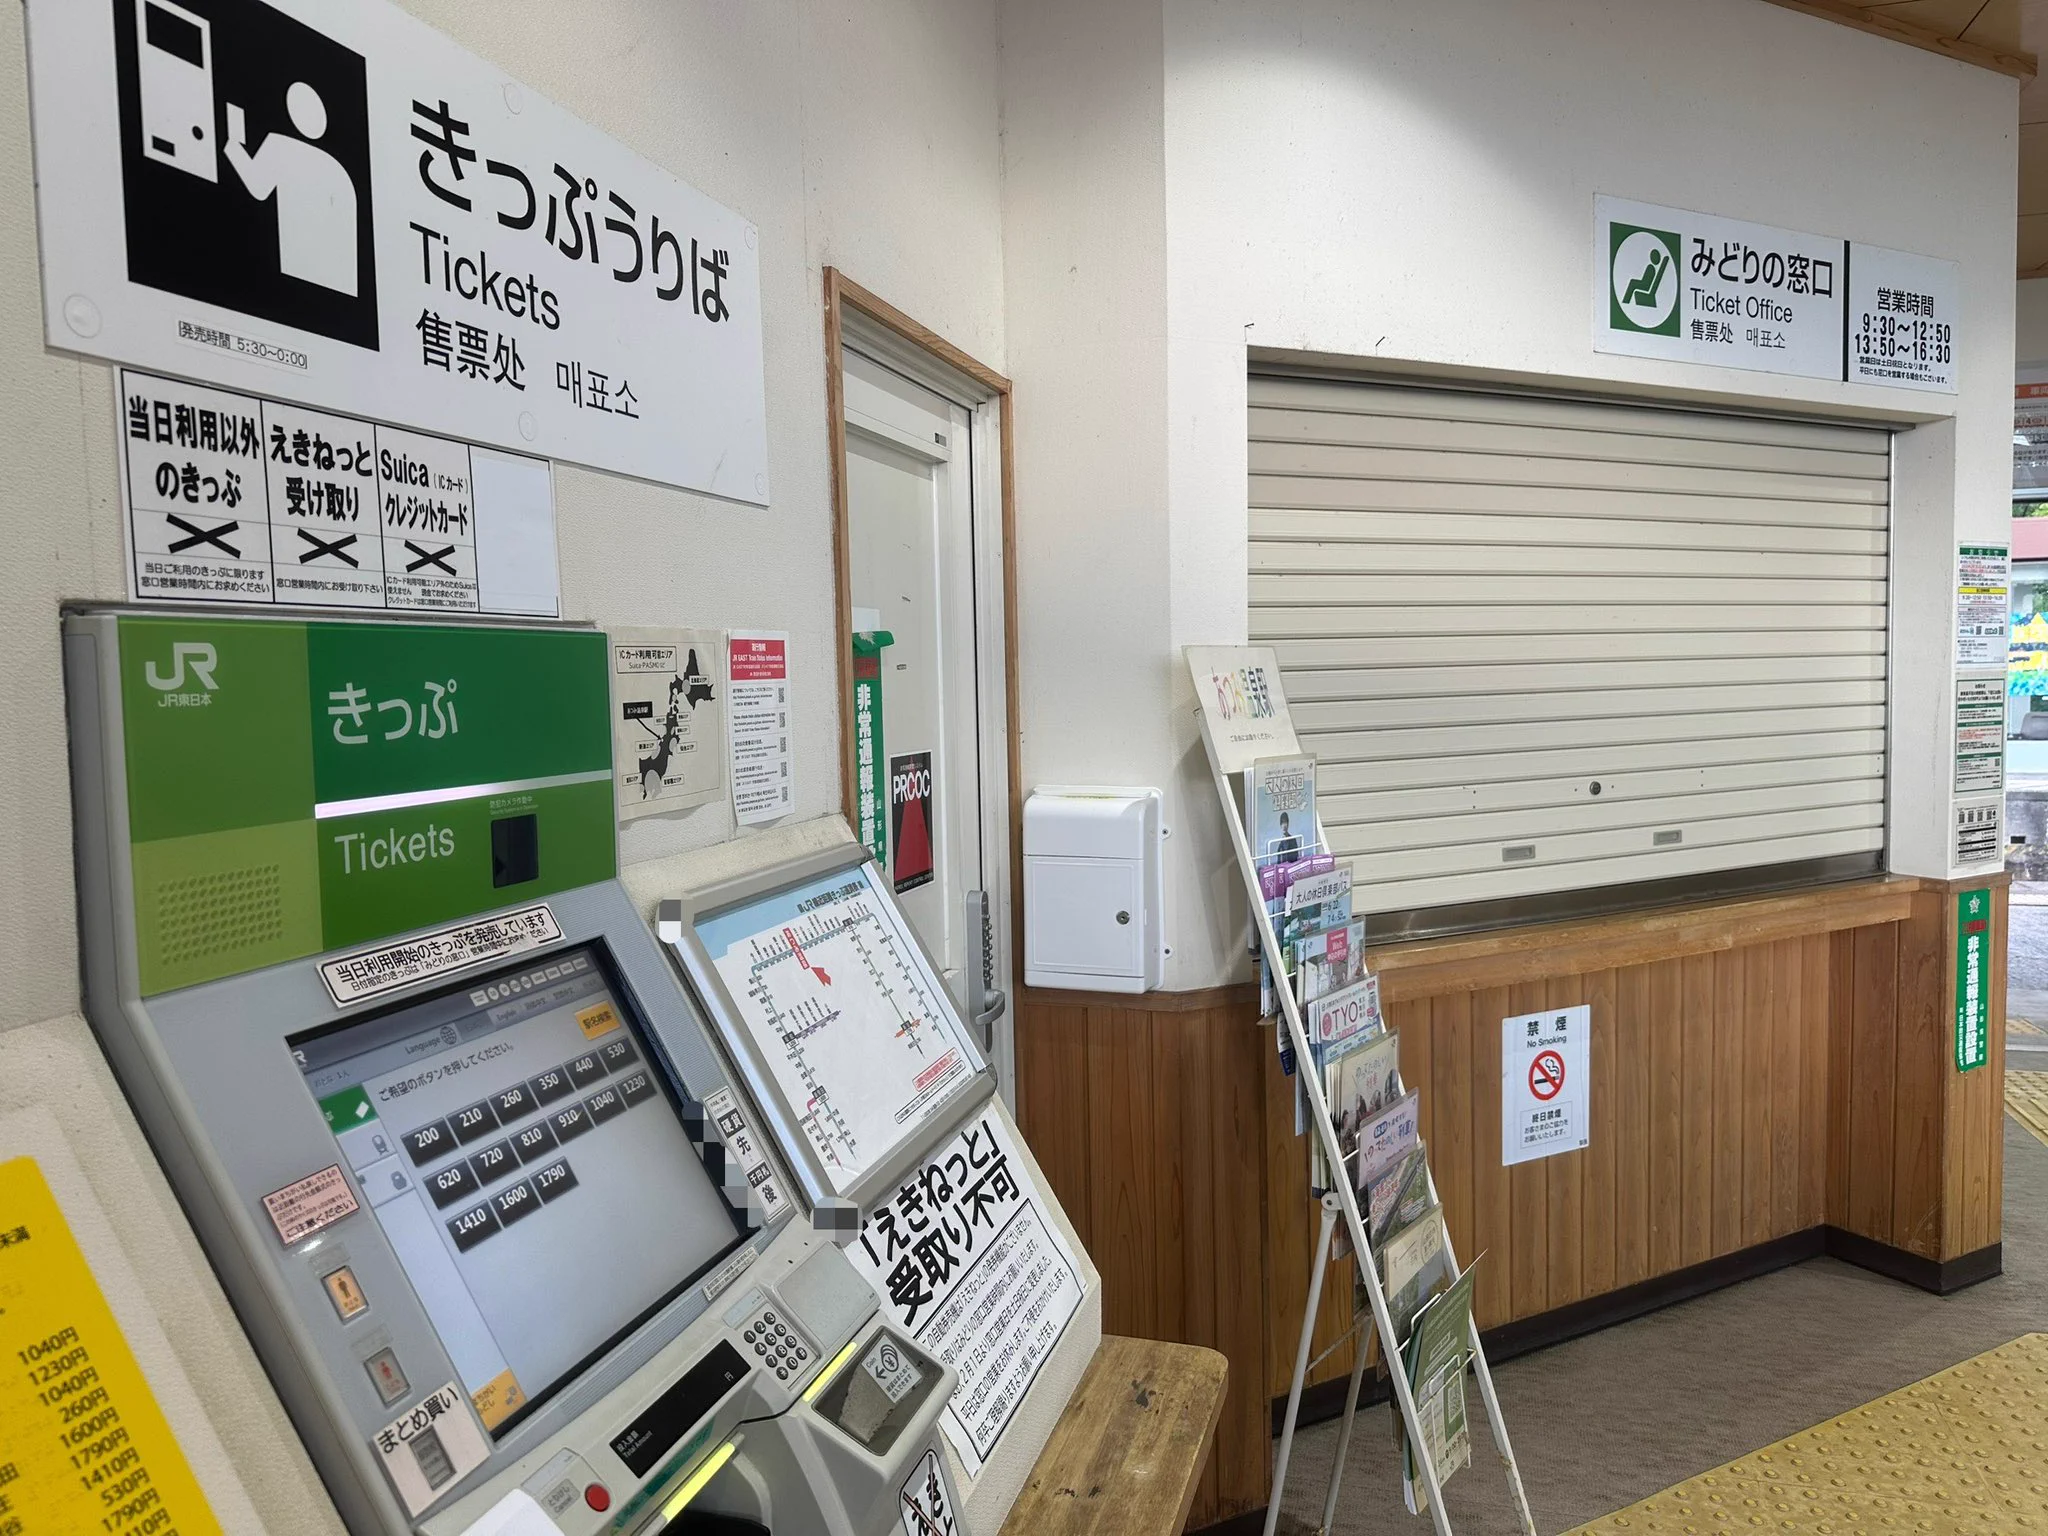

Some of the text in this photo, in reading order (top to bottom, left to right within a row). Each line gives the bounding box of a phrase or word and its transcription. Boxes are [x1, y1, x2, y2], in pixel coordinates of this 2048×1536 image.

[409, 97, 731, 324] きっぷうりば
[409, 222, 561, 330] Tickets
[1691, 238, 1832, 298] みどりの窓口
[1690, 288, 1792, 324] Ticket Office
[1877, 287, 1934, 318] 営業時間
[180, 322, 232, 349] 発売時間
[417, 308, 527, 393] 售票处
[1691, 319, 1734, 344] 售票处
[1746, 328, 1786, 350] 매표소
[556, 362, 641, 420] 매표소
[129, 395, 259, 459] 当日利用以外
[270, 424, 373, 476] えきねっと
[381, 450, 429, 487] Suica
[156, 462, 241, 508] のきっぷ
[286, 476, 358, 522] 受け取り
[385, 493, 467, 535] クレジットカード
[141, 577, 269, 593] 窓口営業時間内にお求めください
[276, 578, 384, 593] 窓口営業時間内にお受け取り下さい
[144, 642, 219, 690] JR
[158, 693, 212, 708] JR東日本
[328, 679, 458, 745] きっぷ
[893, 769, 930, 804] PRCOC
[335, 824, 455, 874] Tickets
[336, 911, 545, 983] 当日利用開始のきっぷを発売しています
[350, 928, 548, 992] 日付指定のきっぷは「みどりの窓口」営業時間中にお求めださい
[1332, 1001, 1358, 1031] TYO
[405, 1037, 441, 1054] Language
[1527, 1035, 1567, 1048] No Smoking
[379, 1041, 514, 1102] ご希望のボタンを押してください。
[414, 1042, 625, 1149] 200 210 260 350 440 530
[437, 1076, 646, 1190] 620 720 810 910 1040 1230
[720, 1112, 742, 1133] 硬貨
[1532, 1109, 1561, 1123] 終日禁煙
[736, 1136, 751, 1155] 先
[750, 1166, 770, 1185] 千円札
[761, 1184, 777, 1204] 後
[860, 1120, 1001, 1267] 「えきねっと」
[455, 1165, 565, 1234] 1410 1600 1790
[885, 1153, 1020, 1327] 受取り不可
[17, 1327, 80, 1366] 1040円
[747, 1313, 775, 1340] 1 2 3
[767, 1333, 775, 1343] 5
[778, 1324, 786, 1333] 6
[27, 1347, 90, 1386] 1230円
[768, 1337, 796, 1364] 7 8 9
[789, 1358, 796, 1366] 0
[38, 1366, 100, 1407] 1040円
[724, 1371, 734, 1382] 円
[58, 1386, 110, 1424] 260円
[377, 1386, 459, 1454] まとめ買い
[59, 1407, 120, 1450] 1600円
[69, 1426, 130, 1470] 1790円
[80, 1446, 140, 1491] 1410円
[100, 1467, 150, 1507] 530円
[101, 1488, 160, 1534] 1790円
[548, 1486, 570, 1507] とりけし
